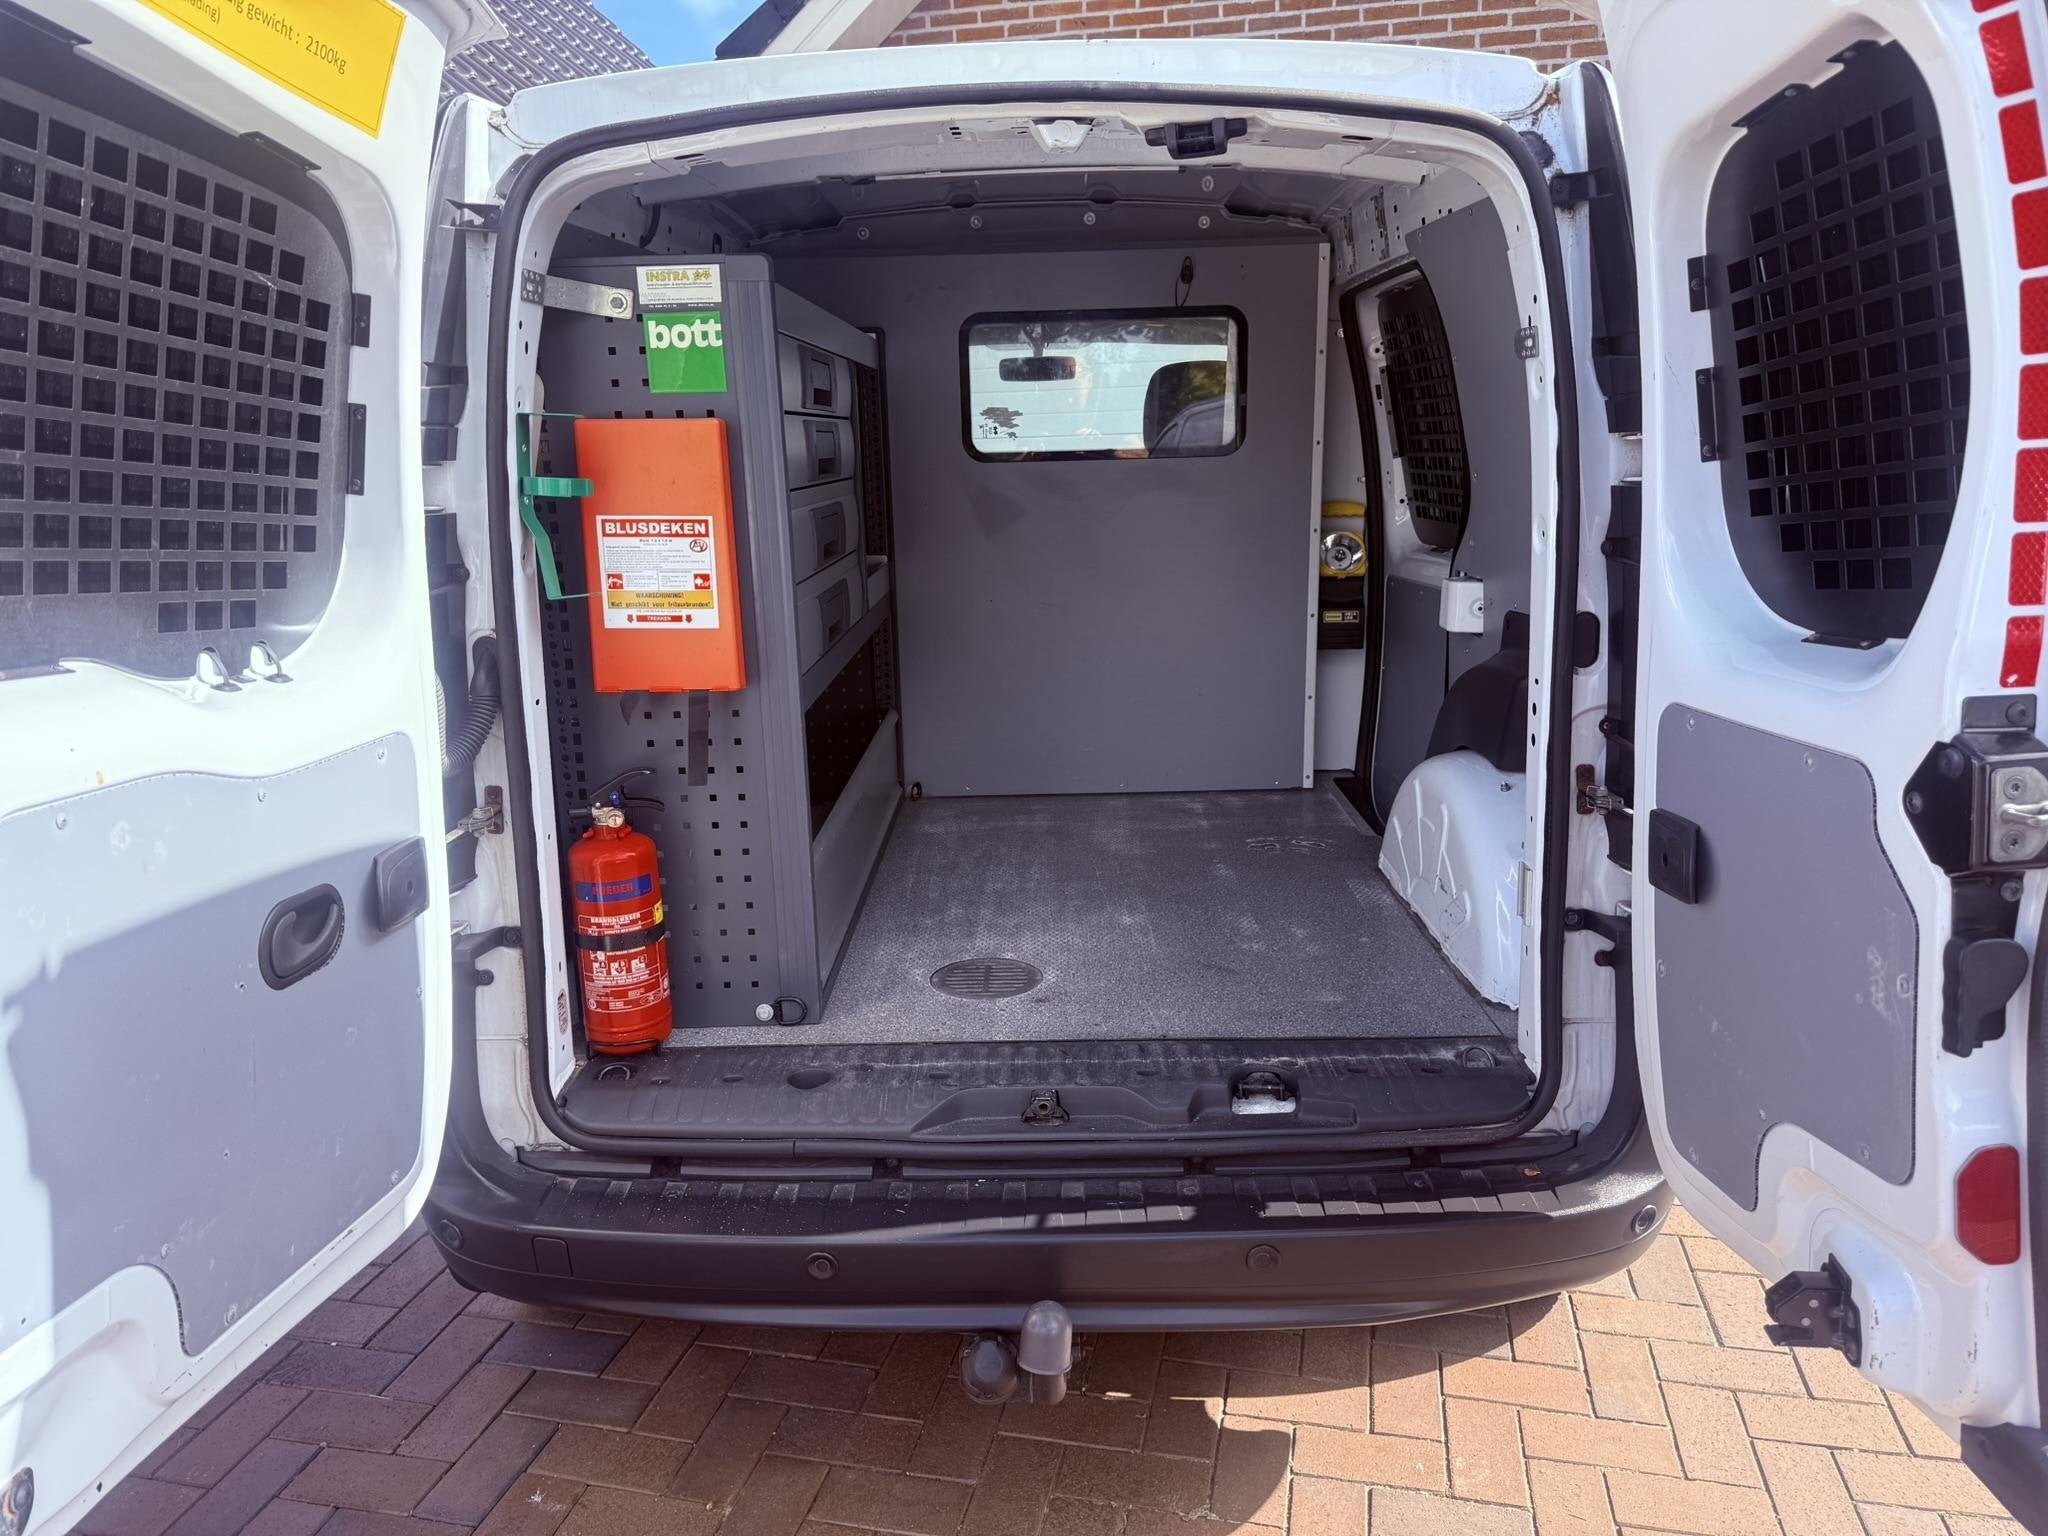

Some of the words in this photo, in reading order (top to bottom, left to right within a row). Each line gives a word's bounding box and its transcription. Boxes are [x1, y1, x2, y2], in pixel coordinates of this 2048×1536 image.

[186, 0, 221, 25] ading)
[246, 2, 293, 40] gewicht
[305, 35, 348, 75] 2100kg
[645, 271, 689, 282] INSTRA
[648, 318, 723, 348] bott
[605, 522, 706, 534] BLUSDEKEN
